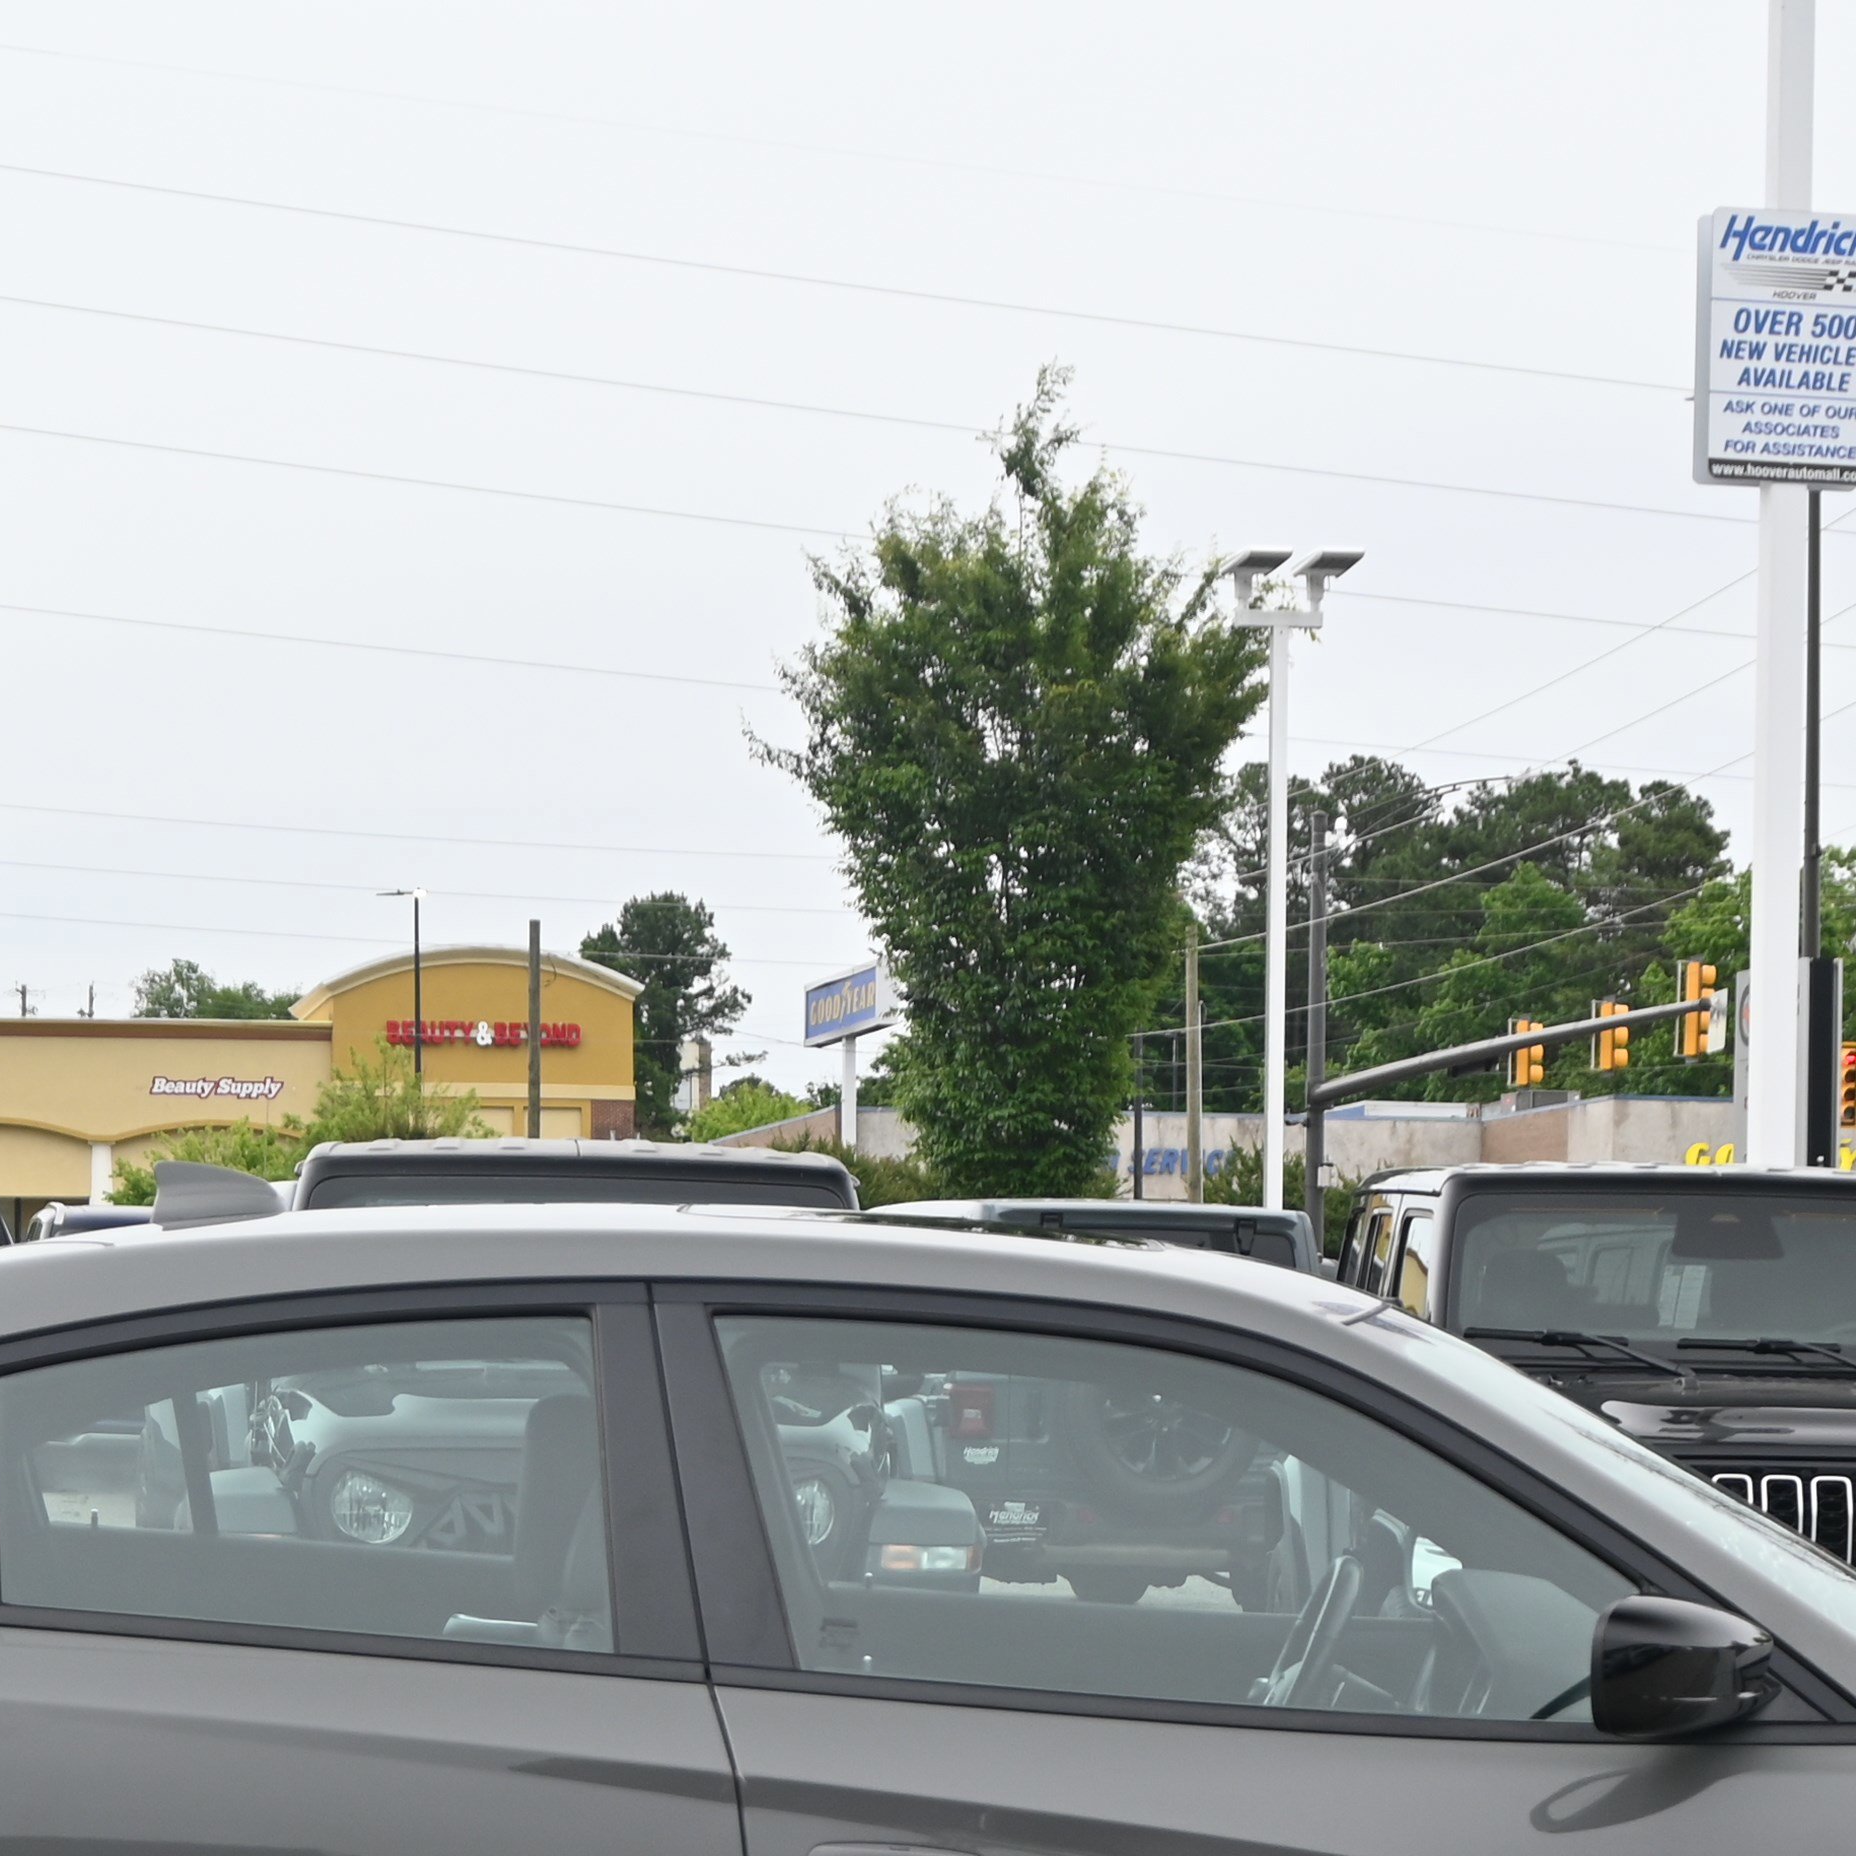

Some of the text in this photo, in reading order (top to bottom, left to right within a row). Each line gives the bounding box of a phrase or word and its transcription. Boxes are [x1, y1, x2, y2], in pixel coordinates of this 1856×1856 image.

[1773, 290, 1817, 300] HOOVER
[1734, 307, 1803, 336] OVER
[1719, 339, 1767, 361] NEW
[1737, 367, 1851, 393] AVAILABLE
[1723, 400, 1755, 414] ASK
[1761, 402, 1794, 417] ONE
[1799, 405, 1822, 418] OF
[1742, 421, 1840, 439] ASSOCIATES
[1724, 439, 1756, 454] FOR
[476, 1021, 492, 1046] &
[149, 1076, 284, 1099] Beauty Supply
